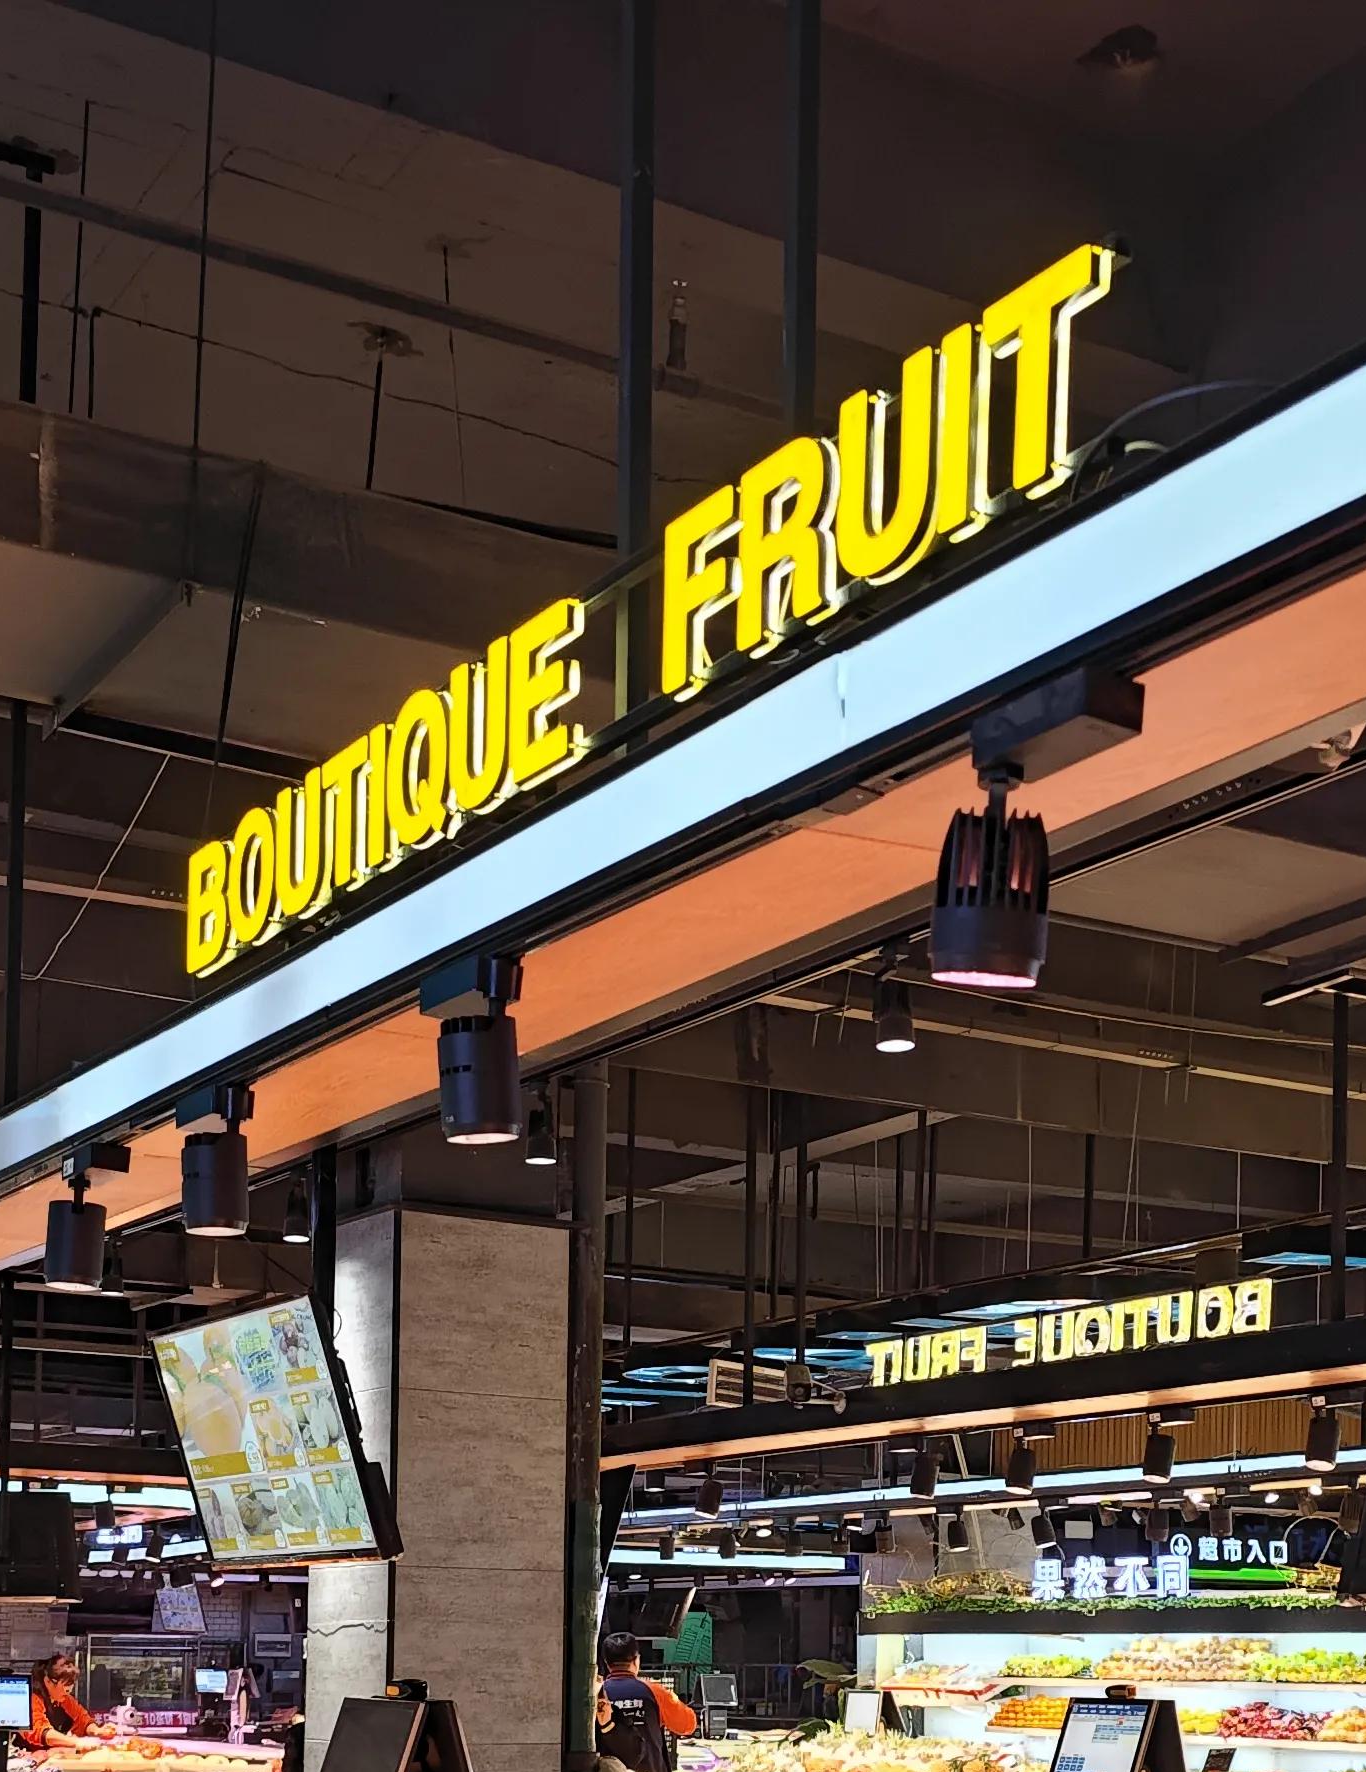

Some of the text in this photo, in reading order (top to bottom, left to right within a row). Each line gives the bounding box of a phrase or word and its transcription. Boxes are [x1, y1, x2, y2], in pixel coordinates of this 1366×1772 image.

[186, 243, 1113, 978] BOUTIQUE FRUIT
[1199, 1536, 1289, 1565] 超市入口
[1032, 1554, 1191, 1600] 果然不同
